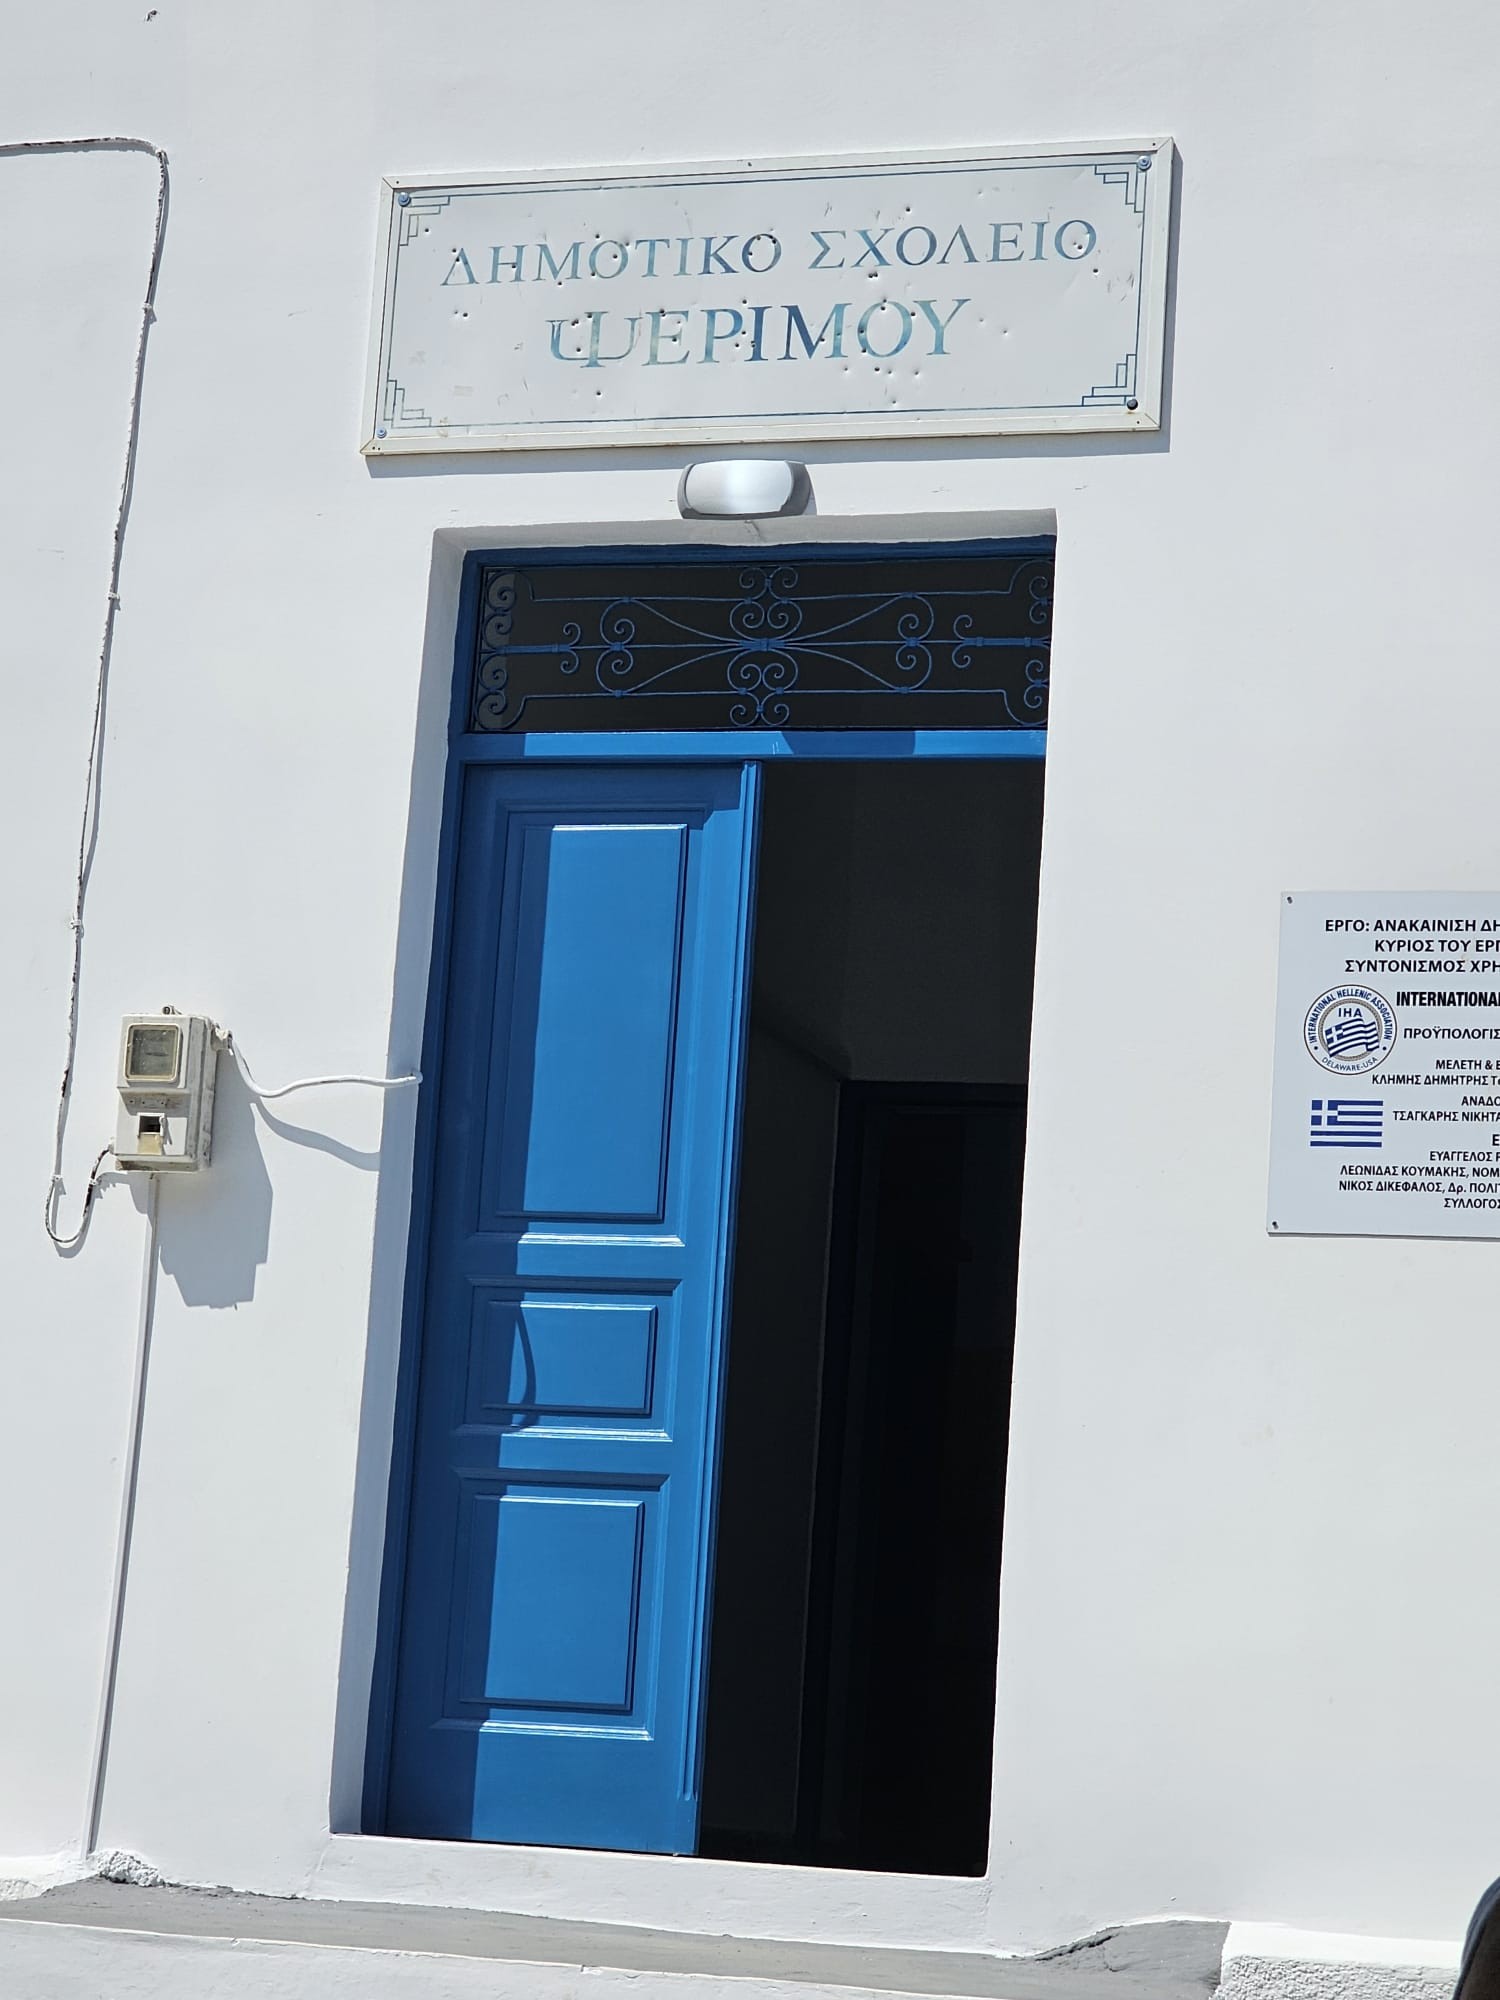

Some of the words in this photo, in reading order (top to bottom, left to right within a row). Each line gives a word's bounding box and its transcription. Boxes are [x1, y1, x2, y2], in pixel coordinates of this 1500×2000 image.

[440, 232, 783, 287] ΔΗΜΟΤΙΚΟ
[808, 218, 1098, 270] ΣΧΟΛΕΙΟ
[546, 296, 973, 369] ΨΕΡΙΜΟΥ
[1325, 919, 1370, 932] ΕΡΓΟ:
[1373, 919, 1477, 932] ΑΝΑΚΑΙΝΙΣΗ
[1374, 939, 1435, 953] ΚΥΡΙΟΣ
[1437, 939, 1472, 953] ΤΟΥ
[1344, 959, 1466, 973] ΣΥΝΤΟΝΙΣΜΟΣ
[1396, 991, 1500, 1007] INTERNATIONA
[1307, 993, 1337, 1044] INTERNATIONAL
[1336, 988, 1372, 1000] HELLENIC
[1370, 996, 1393, 1041] ASSOCIATION
[1338, 1007, 1363, 1018] IHA
[1321, 1056, 1379, 1072] DELAWARE-USA
[1435, 1059, 1482, 1071] ΜΕΛΕΤΗ
[1484, 1059, 1493, 1071] &
[1371, 1074, 1422, 1085] ΚΛΗΜΗΣ
[1423, 1074, 1489, 1086] ΔΗΜΗΤΡΗΣ
[1392, 1110, 1459, 1122] ΤΣΑΓΚΑΡΗΣ
[1429, 1150, 1493, 1162] ΕΥΑΓΓΕΛΟΣ
[1340, 1164, 1399, 1176] ΛΕΩΝΙΔΑΣ
[1401, 1165, 1470, 1179] ΚΟΥΜΑΚΗΣ,
[1338, 1180, 1374, 1191] ΝΙΚΟΣ
[1375, 1180, 1447, 1194] ΔΙΚΕΦΑΛΟΣ,
[1447, 1182, 1469, 1196] Δρ.
[1443, 1197, 1500, 1209] ΣΥΛΛΟΓΟ
